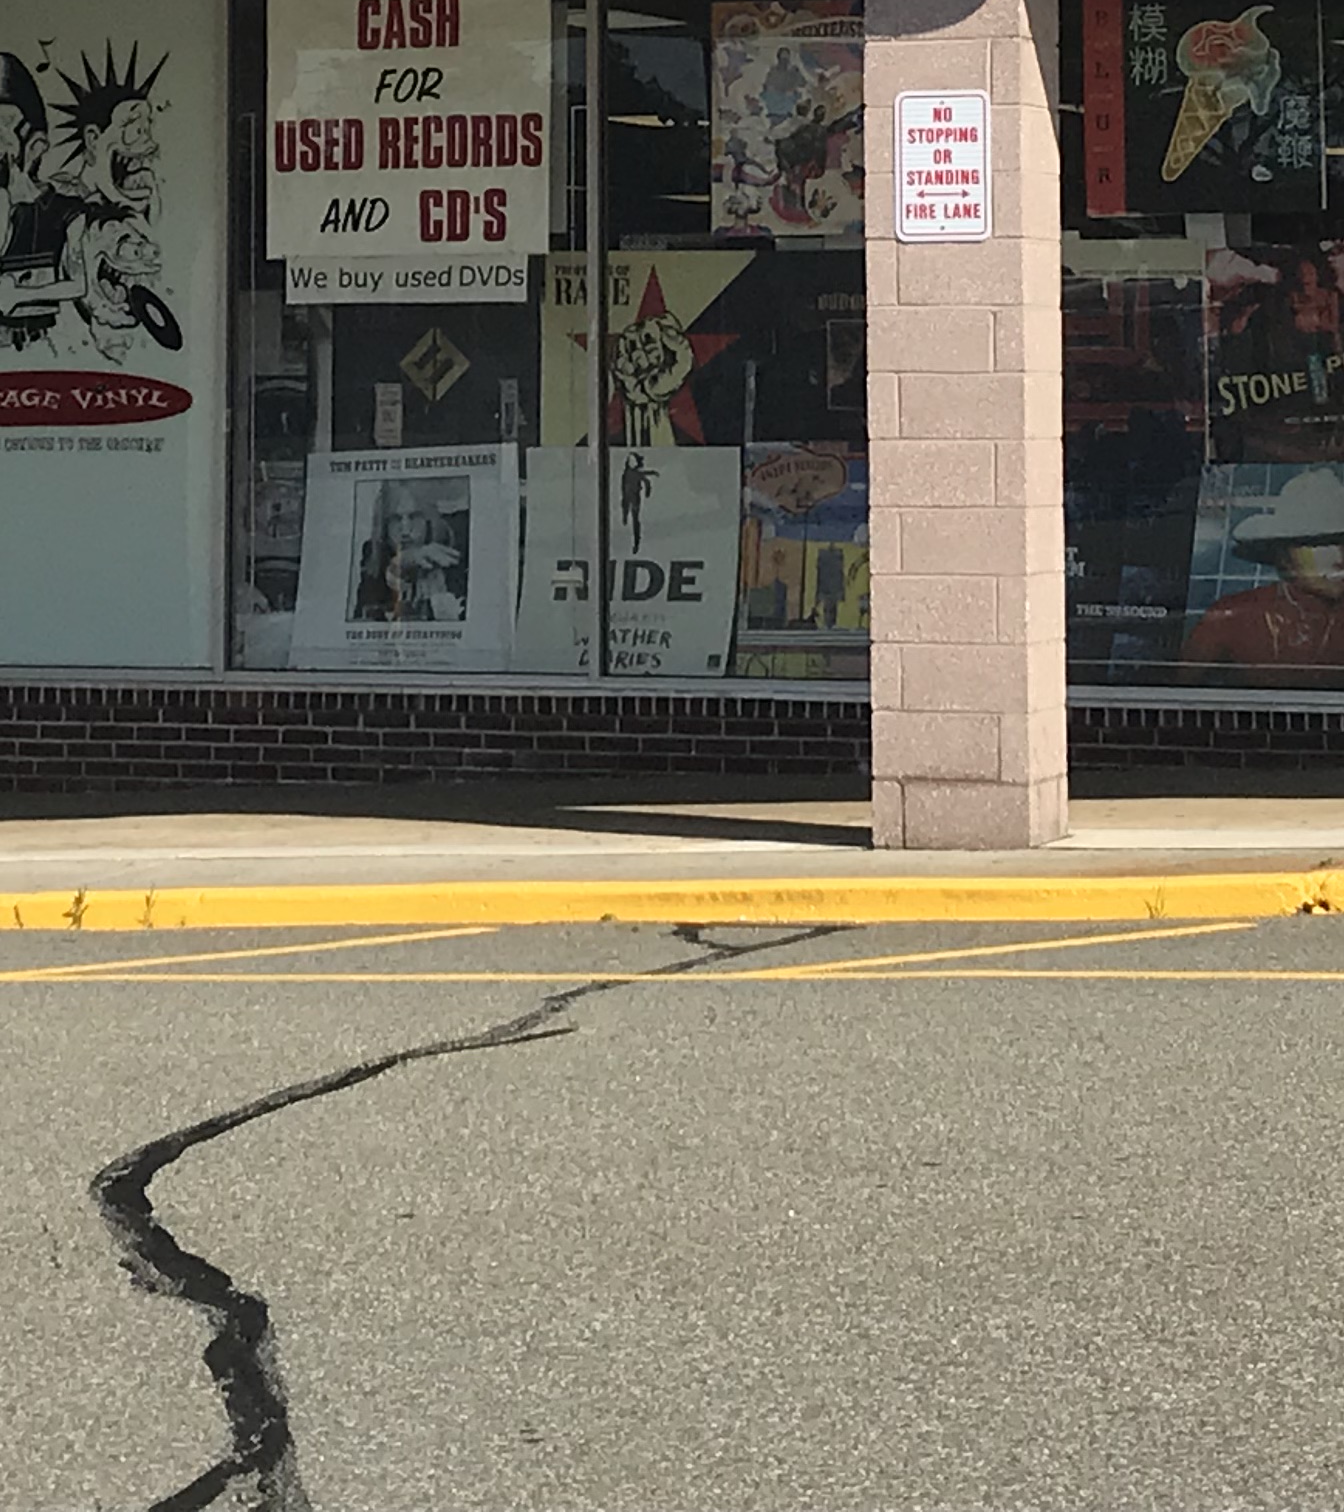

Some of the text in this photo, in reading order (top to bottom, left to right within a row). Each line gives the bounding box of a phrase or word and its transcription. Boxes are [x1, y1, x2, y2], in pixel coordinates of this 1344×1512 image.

[1128, 1, 1169, 87] 模糊
[374, 67, 444, 103] FOR
[1093, 9, 1113, 185] BLUR
[932, 107, 953, 123] NO
[274, 113, 543, 172] USED RECORDS
[906, 127, 979, 144] STOPPING
[932, 148, 953, 164] OR
[906, 169, 980, 186] STANDING
[320, 188, 507, 242] AND CD'S
[905, 203, 981, 219] FIRE LANE
[290, 265, 525, 292] We buy used DVDs
[554, 278, 631, 306] RAE
[1217, 371, 1308, 416] STONE
[553, 559, 705, 602] RIDE
[573, 627, 673, 649] WATHER
